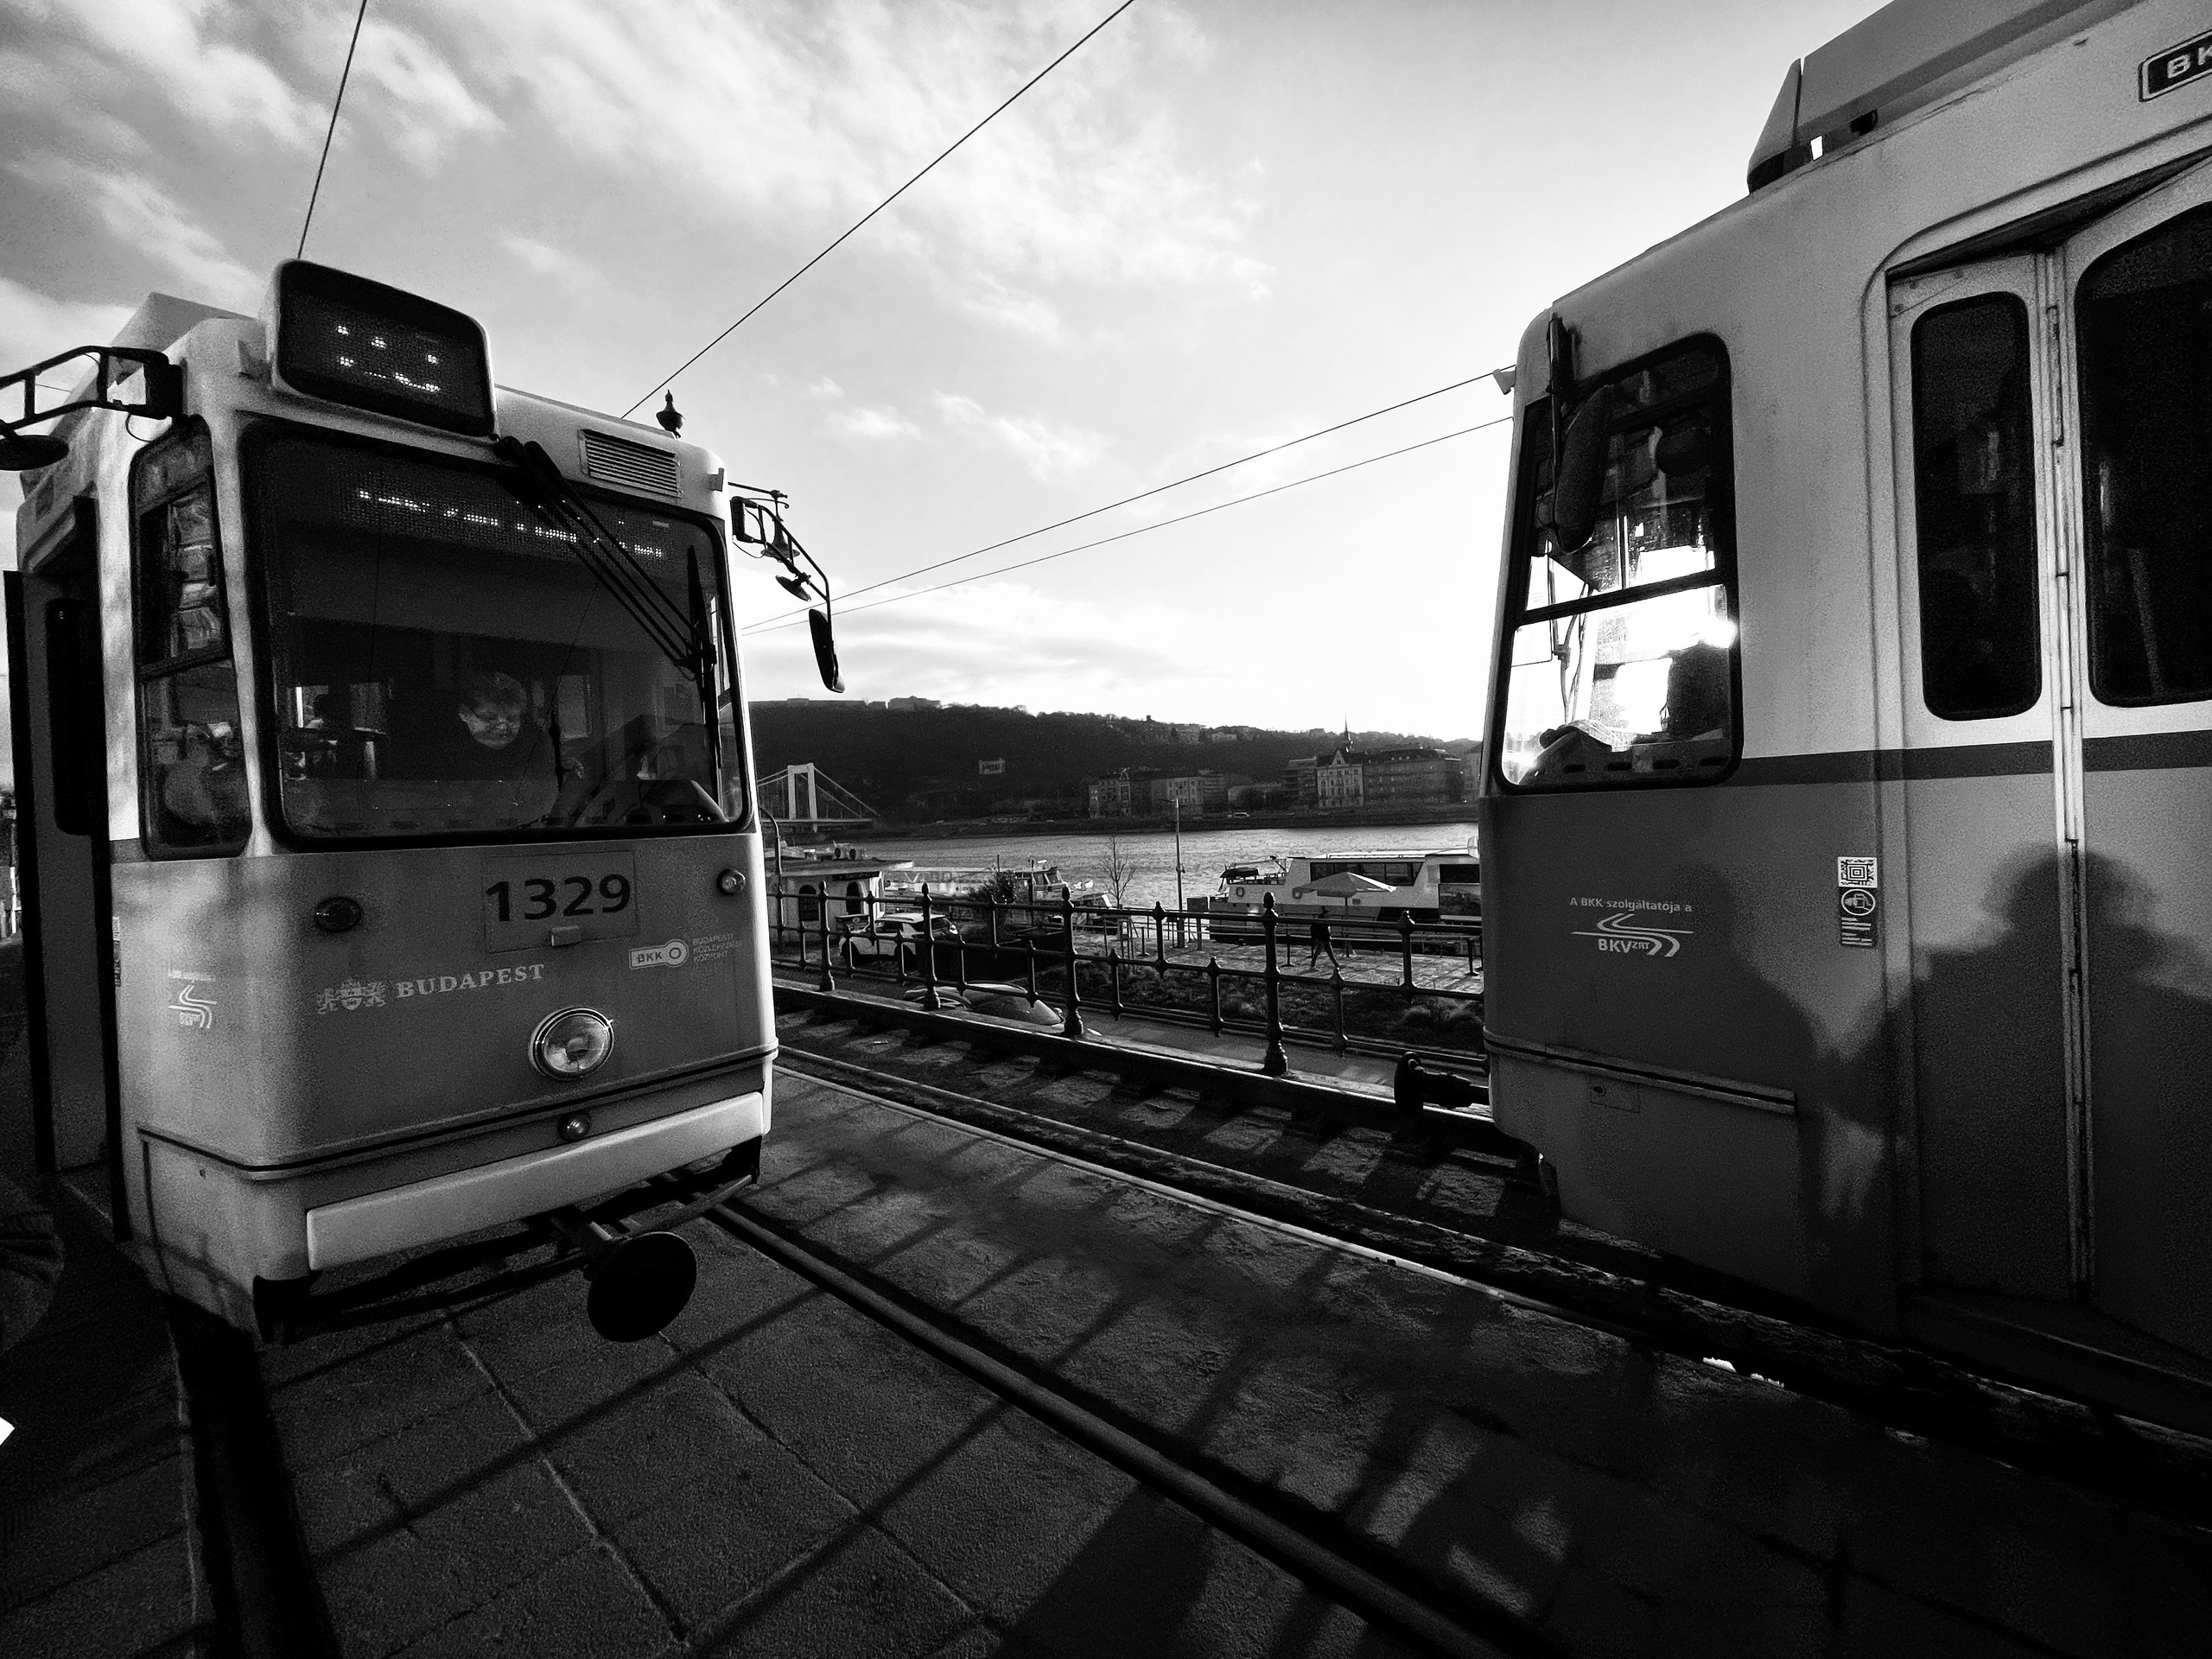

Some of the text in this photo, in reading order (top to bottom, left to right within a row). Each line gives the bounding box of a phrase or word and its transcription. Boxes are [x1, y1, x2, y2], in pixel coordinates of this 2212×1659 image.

[485, 874, 631, 922] 1329
[1569, 897, 1692, 913] A BKK szolgáltatója a
[637, 951, 662, 964] BKK
[396, 963, 544, 998] BUDAPEST
